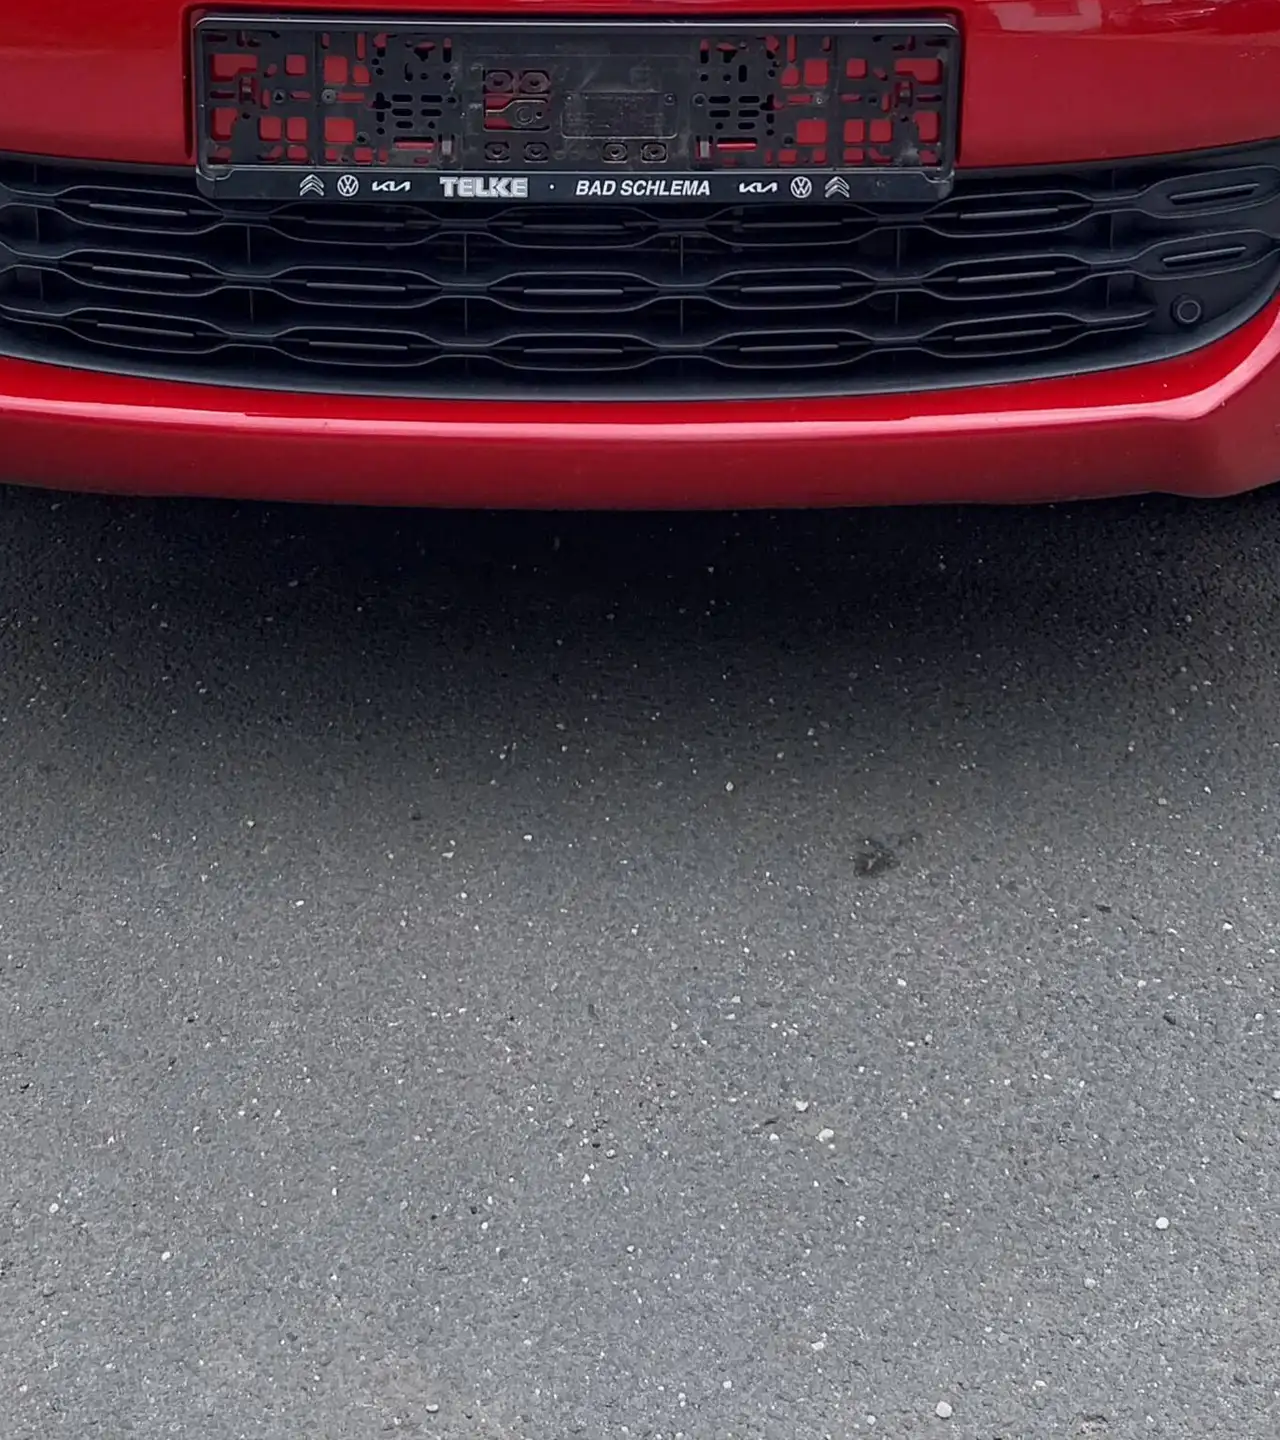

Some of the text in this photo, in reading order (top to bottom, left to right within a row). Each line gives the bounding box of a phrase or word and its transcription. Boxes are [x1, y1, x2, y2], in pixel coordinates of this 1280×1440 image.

[439, 176, 529, 198] TELKE
[575, 180, 617, 196] BAD
[620, 179, 711, 197] SCHLEMA
